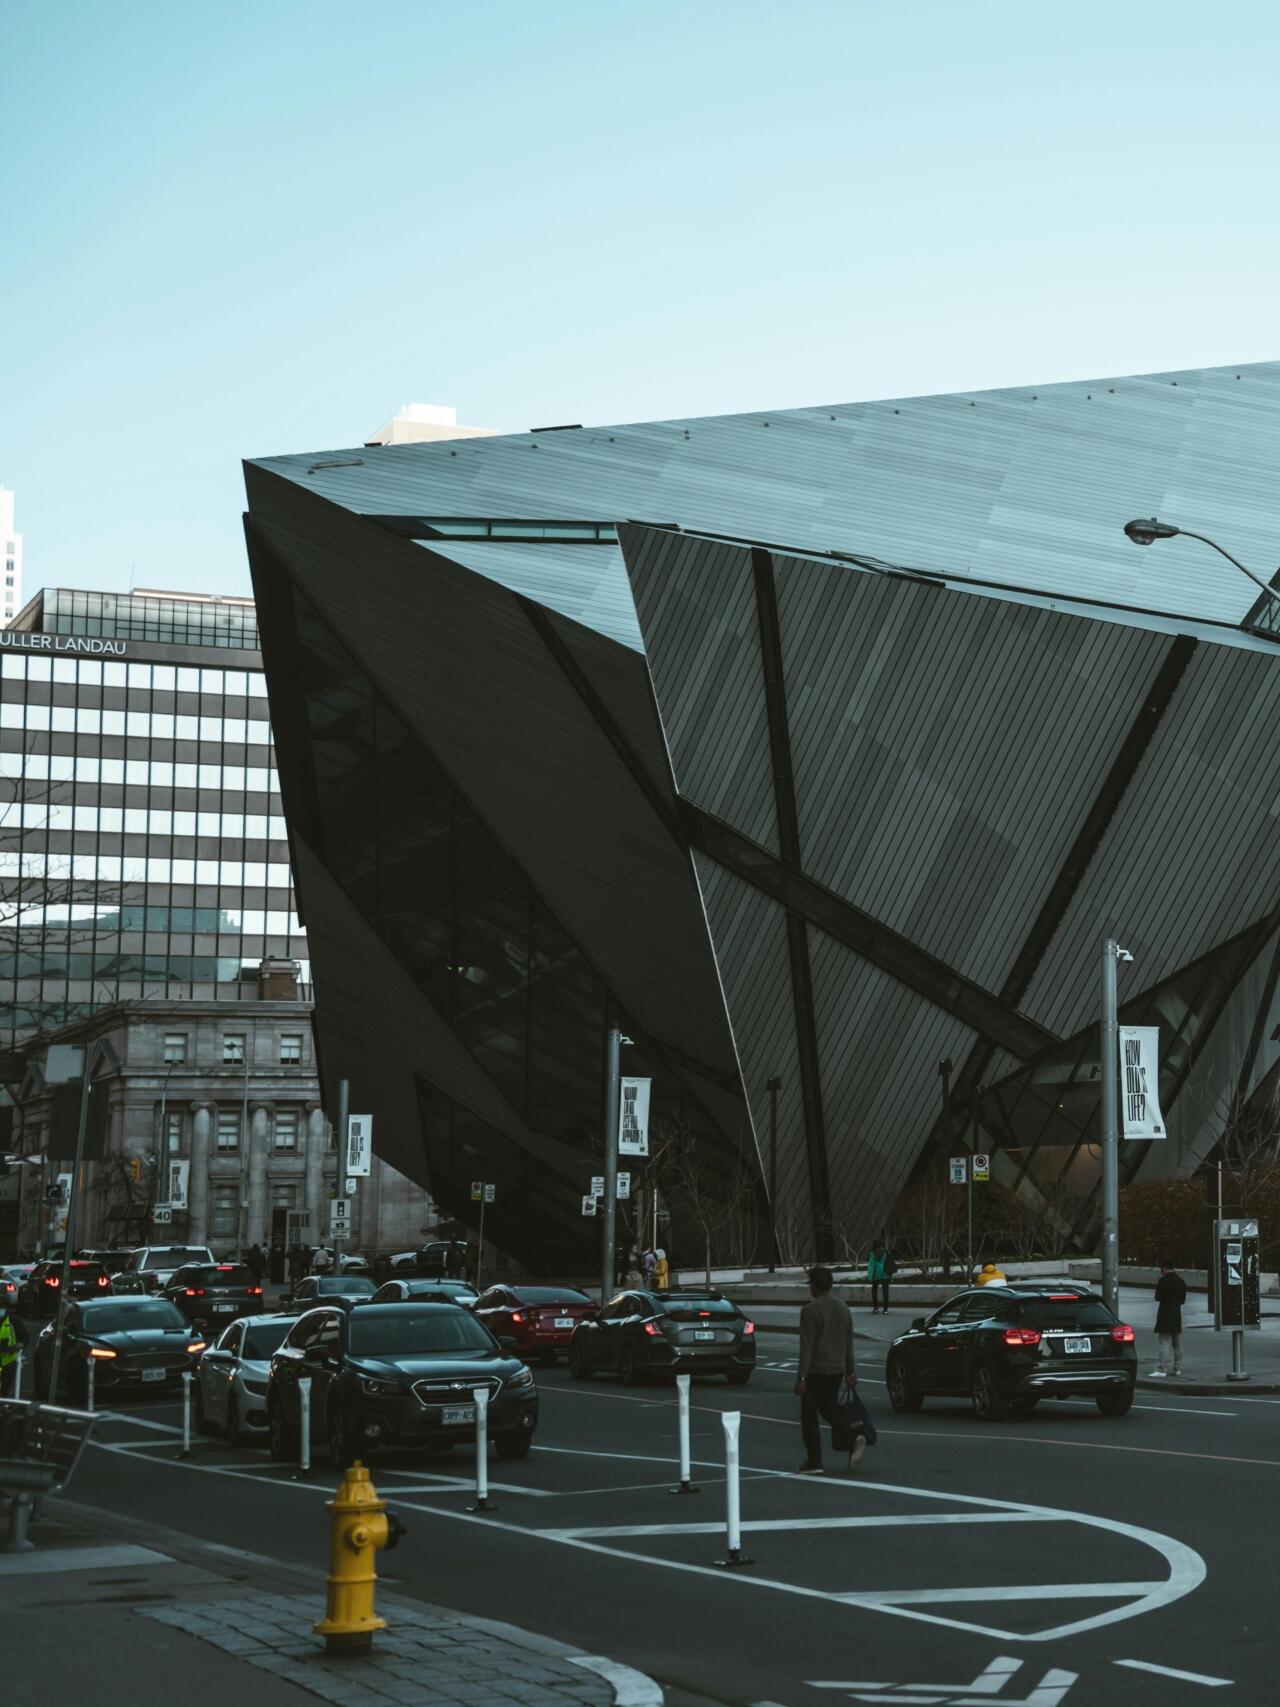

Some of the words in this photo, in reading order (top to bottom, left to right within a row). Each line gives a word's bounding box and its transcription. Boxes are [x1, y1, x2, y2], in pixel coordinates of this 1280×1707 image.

[55, 637, 126, 655] LANDAU
[1125, 1039, 1141, 1066] HOW
[1126, 1067, 1140, 1094] OLD
[1127, 1094, 1145, 1122] LIFE?
[156, 1211, 171, 1221] 40
